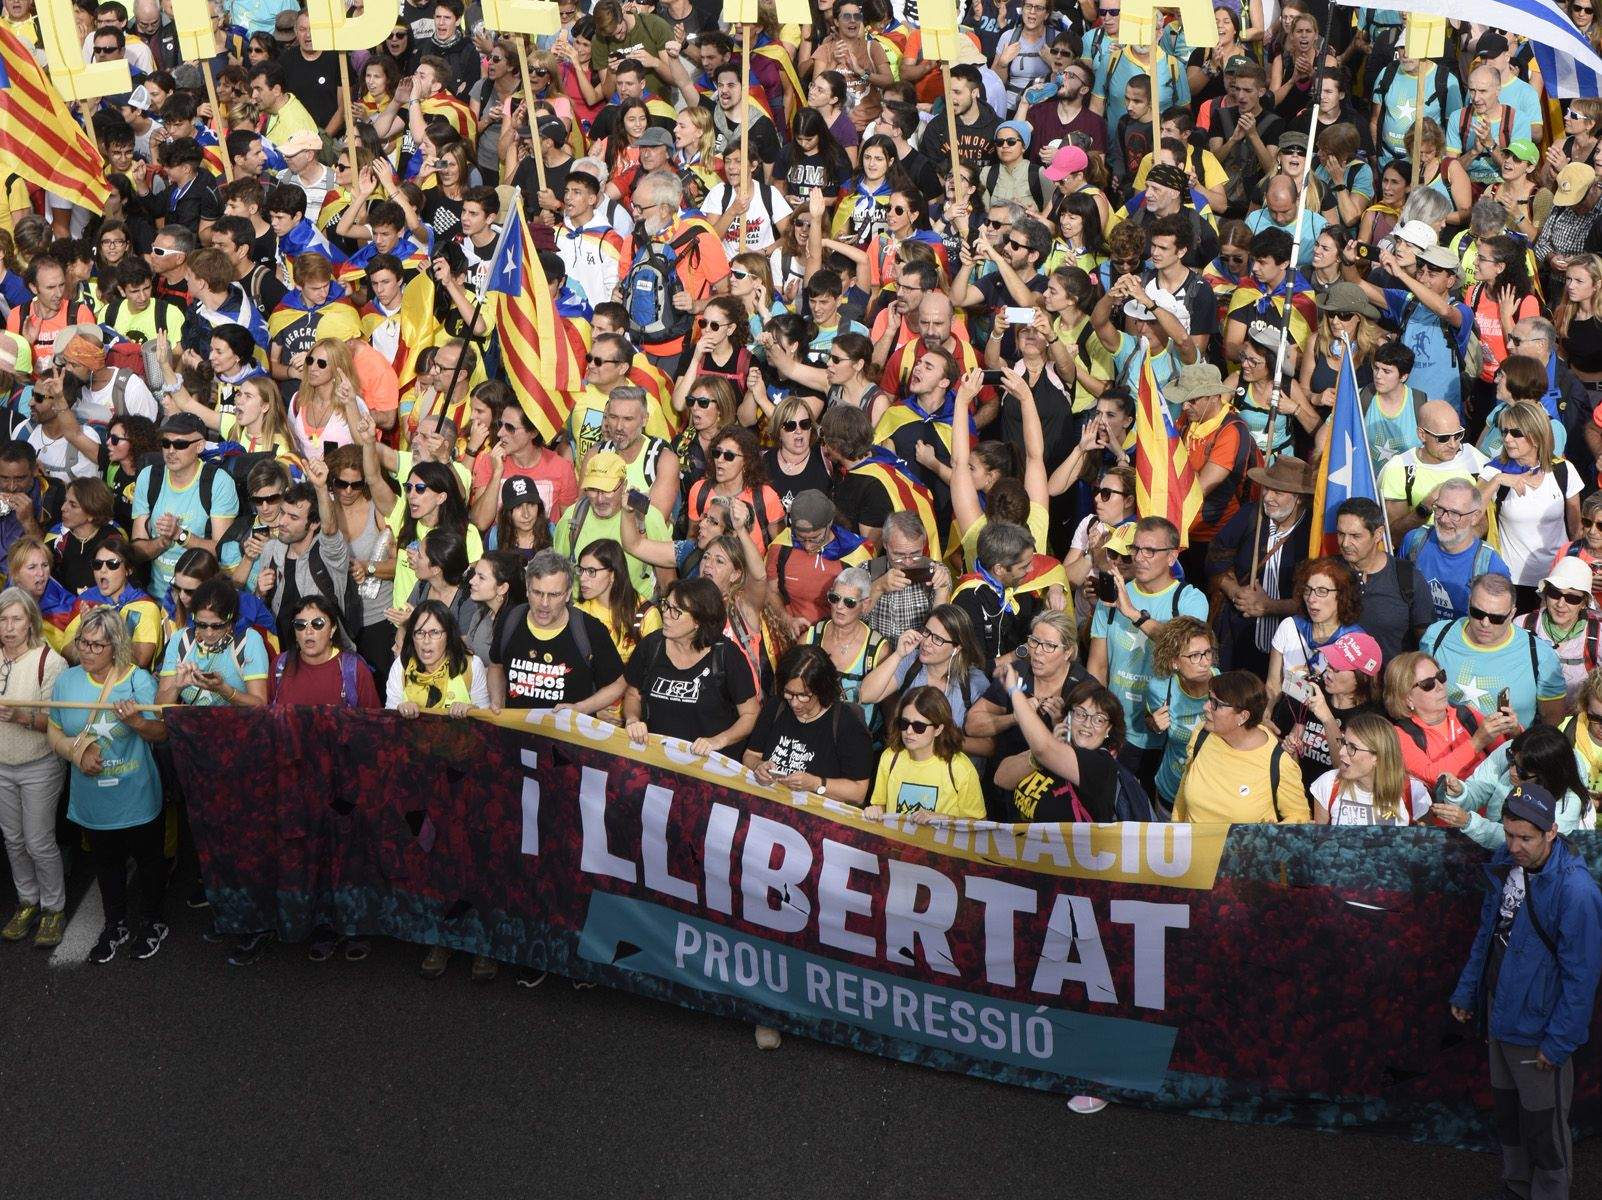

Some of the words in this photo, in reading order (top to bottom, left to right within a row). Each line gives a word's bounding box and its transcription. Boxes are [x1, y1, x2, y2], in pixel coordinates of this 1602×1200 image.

[511, 658, 566, 677] LLIBERTAT
[509, 669, 566, 690] PRESOS
[509, 682, 565, 701] POLÍTICS!
[1341, 805, 1367, 819] GIVE
[579, 765, 1191, 1011] LLIBERTAT
[674, 921, 789, 995] PROU
[805, 960, 1055, 1060] REPRESSIÓ
